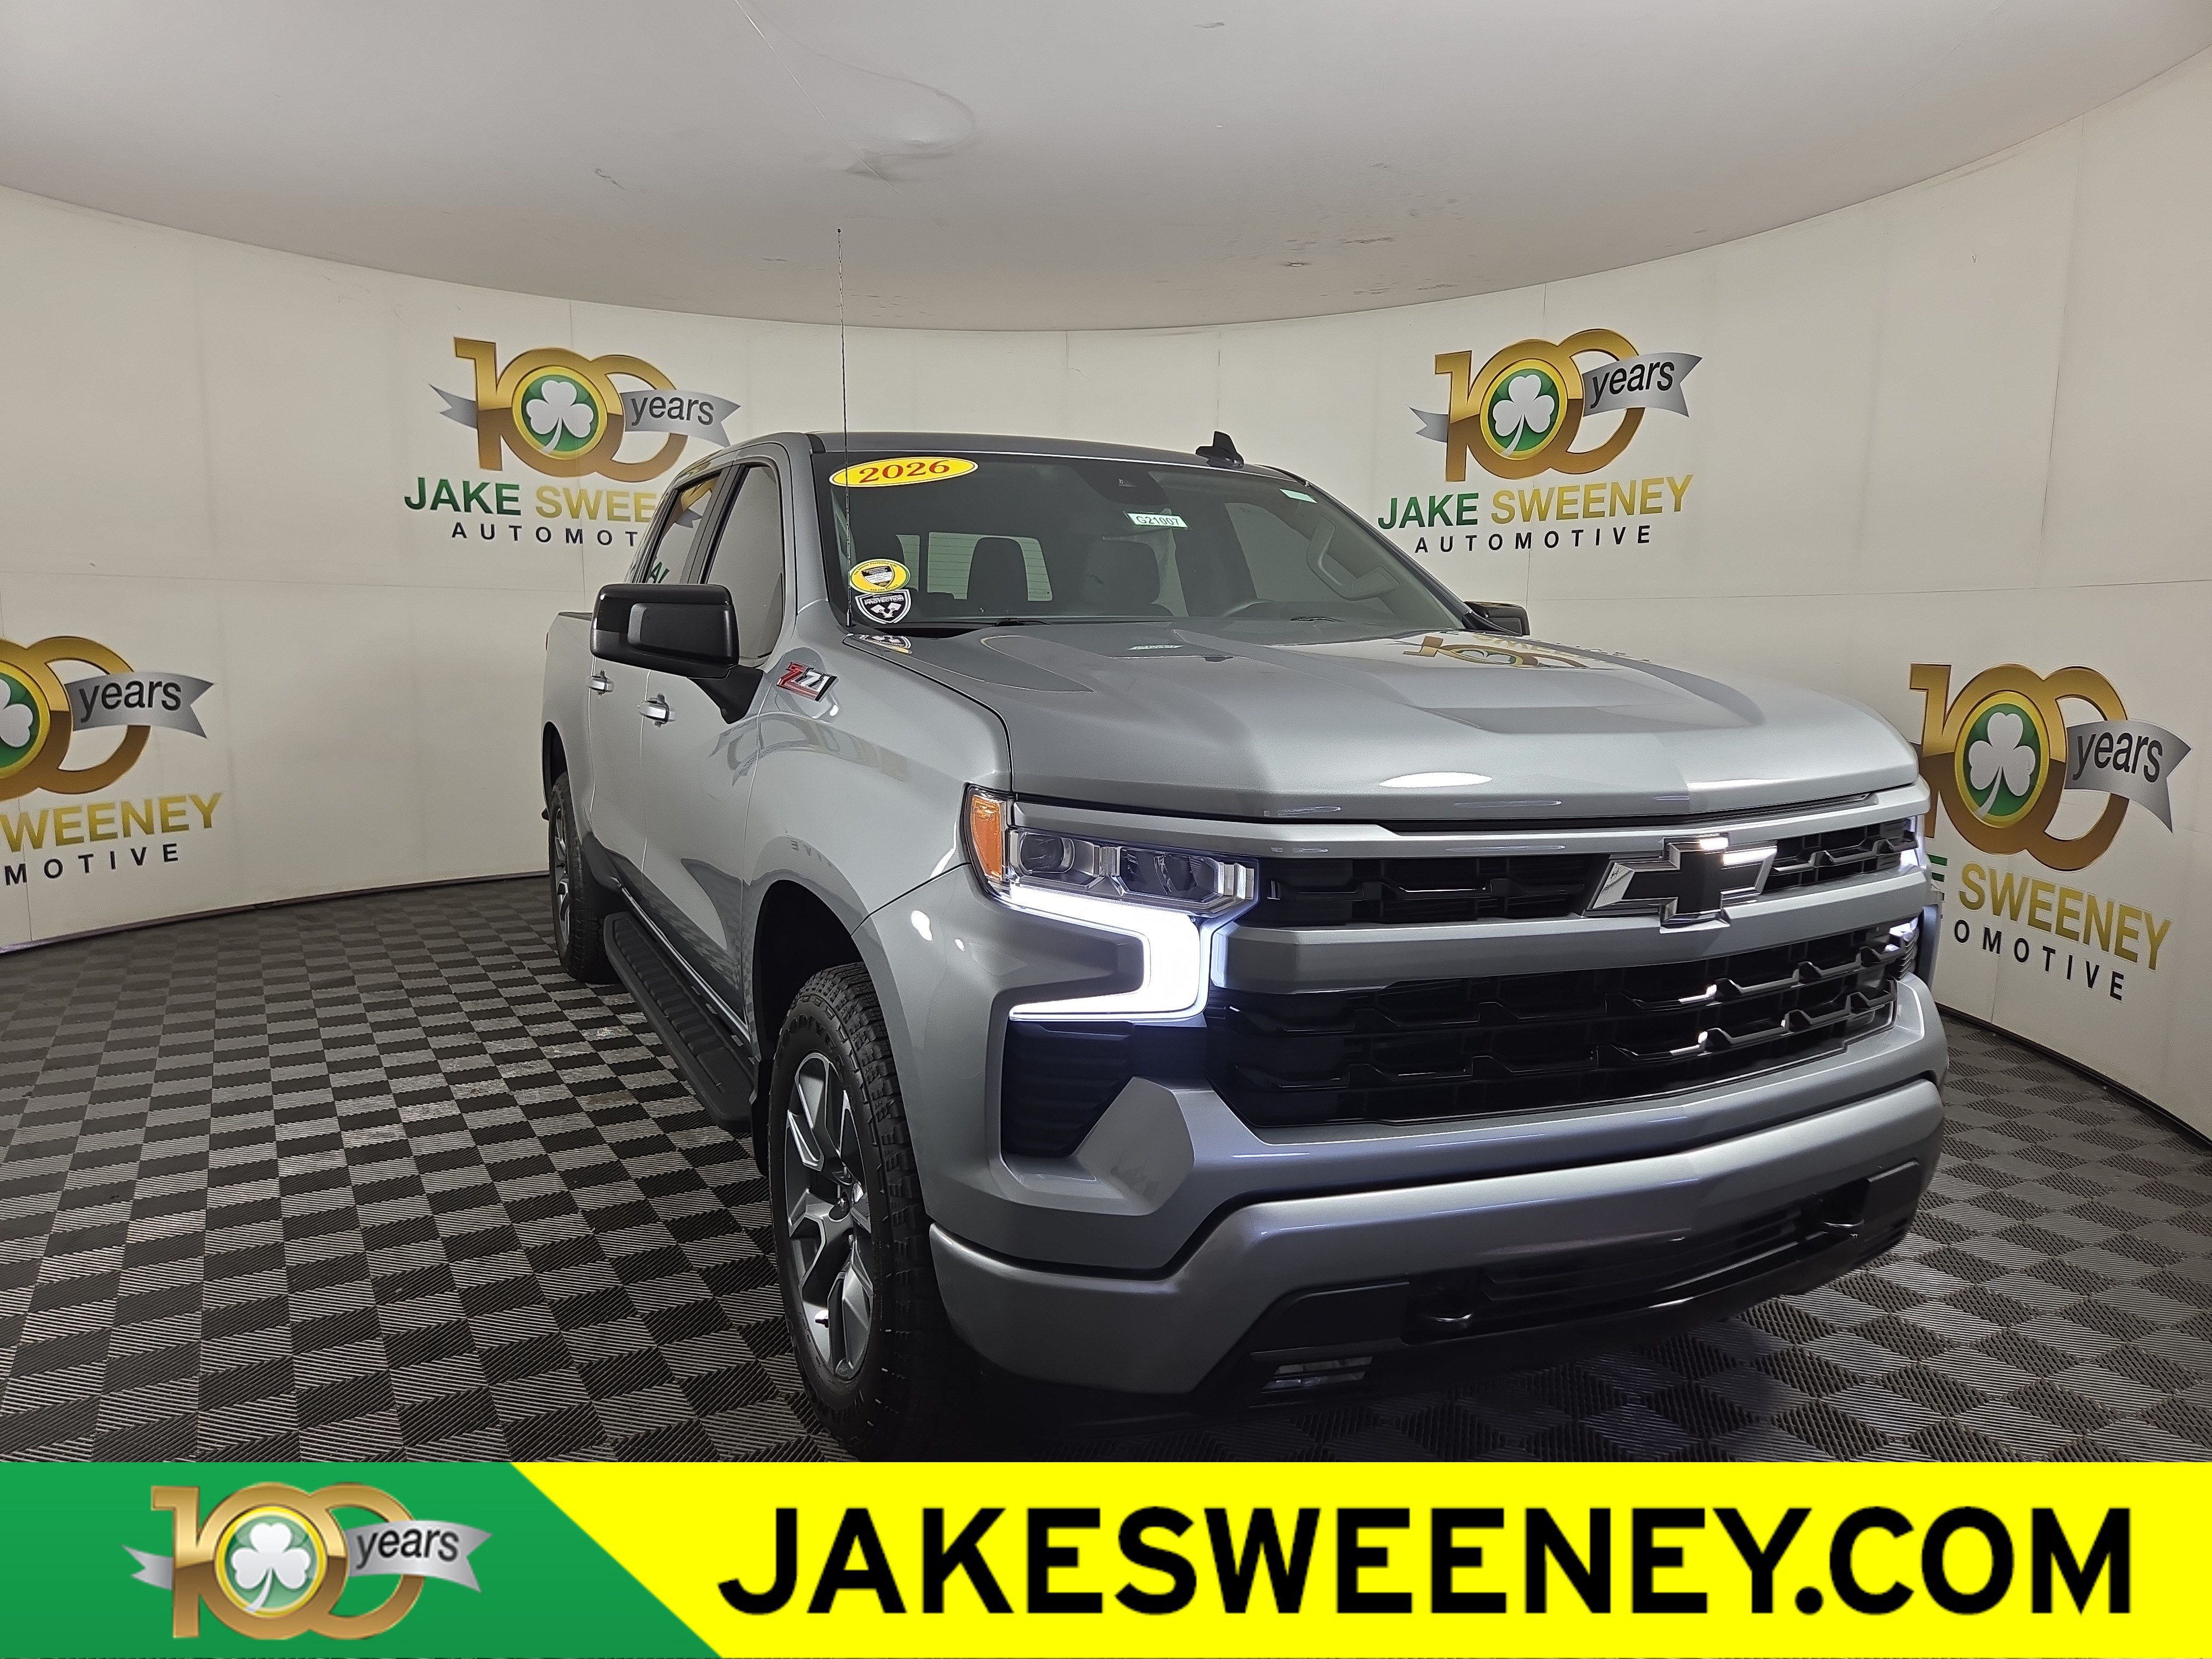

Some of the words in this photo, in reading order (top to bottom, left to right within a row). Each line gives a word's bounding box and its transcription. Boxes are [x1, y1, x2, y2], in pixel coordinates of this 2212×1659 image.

[1435, 328, 1645, 483] 100
[1590, 361, 1675, 408] years
[453, 336, 689, 483] 100
[631, 393, 715, 427] years
[859, 460, 950, 484] 2026
[404, 477, 522, 516] JAKE
[1378, 493, 1479, 529] JAKE
[1491, 474, 1694, 524] SWEENEY
[451, 522, 638, 547] AUTOMOT
[1136, 516, 1180, 526] G21007
[1414, 525, 1651, 554] AUTOMOTIVE
[864, 596, 904, 606] PROTECTION
[79, 680, 182, 723] years
[1909, 663, 2130, 872] 100
[2073, 732, 2163, 783] years
[4, 843, 179, 886] MOTIVE
[1959, 862, 2172, 971] SWEENEY
[1954, 919, 2125, 1001] OMOTIVE
